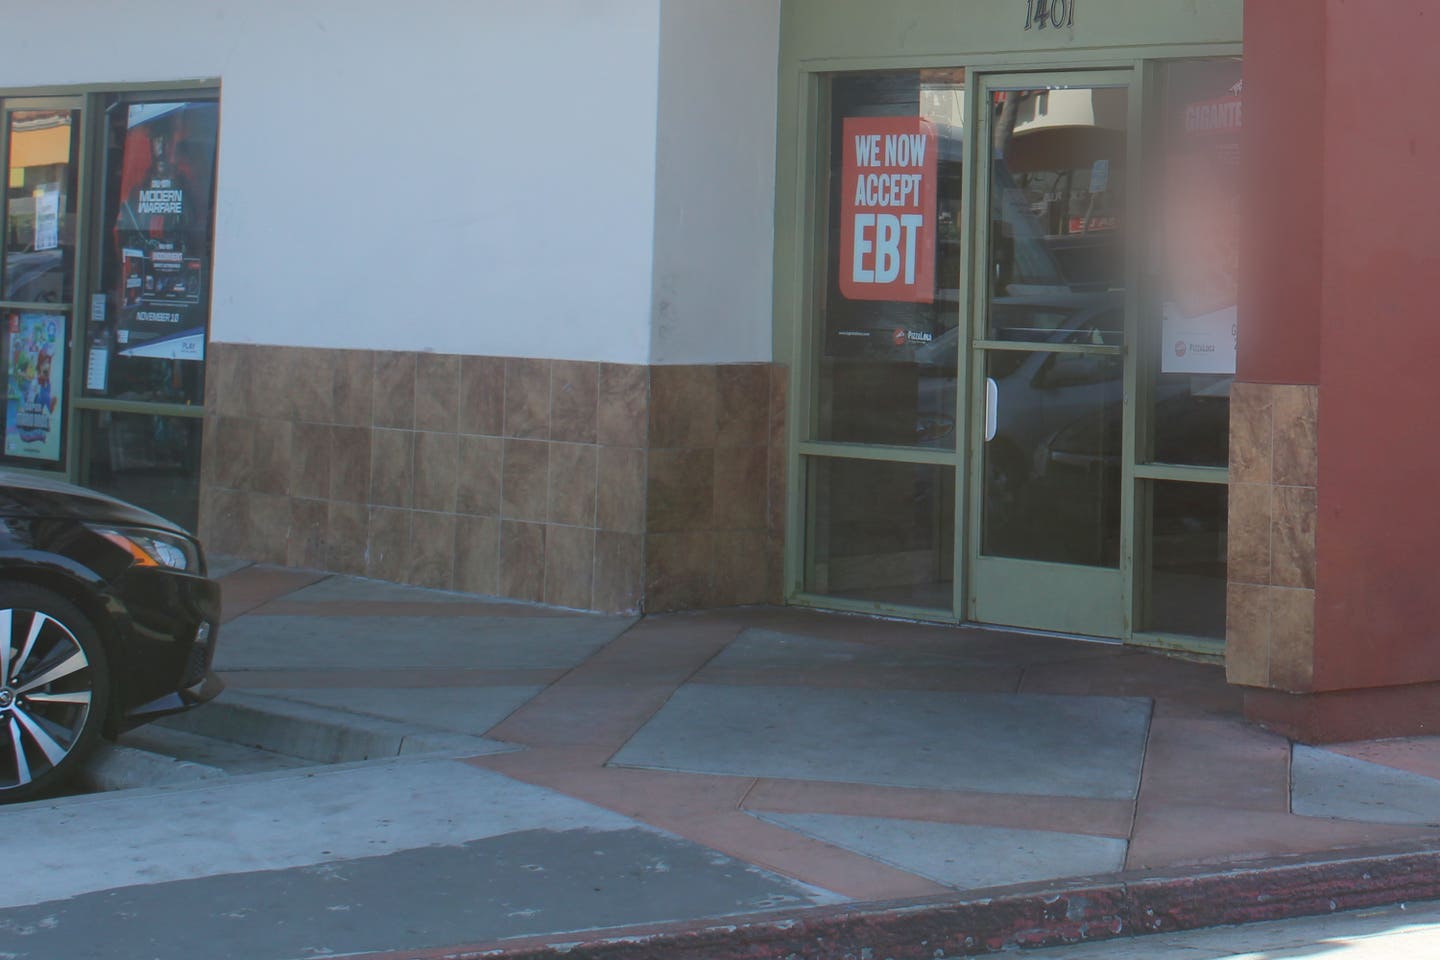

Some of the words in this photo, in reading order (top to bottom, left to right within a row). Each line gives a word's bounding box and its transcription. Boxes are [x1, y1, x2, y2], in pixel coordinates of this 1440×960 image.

[855, 134, 882, 168] WE
[885, 133, 927, 168] NOW
[140, 190, 182, 202] MODERN
[854, 173, 923, 208] ACCEPT
[138, 202, 182, 214] WARFARE
[853, 213, 924, 285] EBT
[137, 311, 170, 321] NOVEMBER
[171, 313, 180, 323] 10
